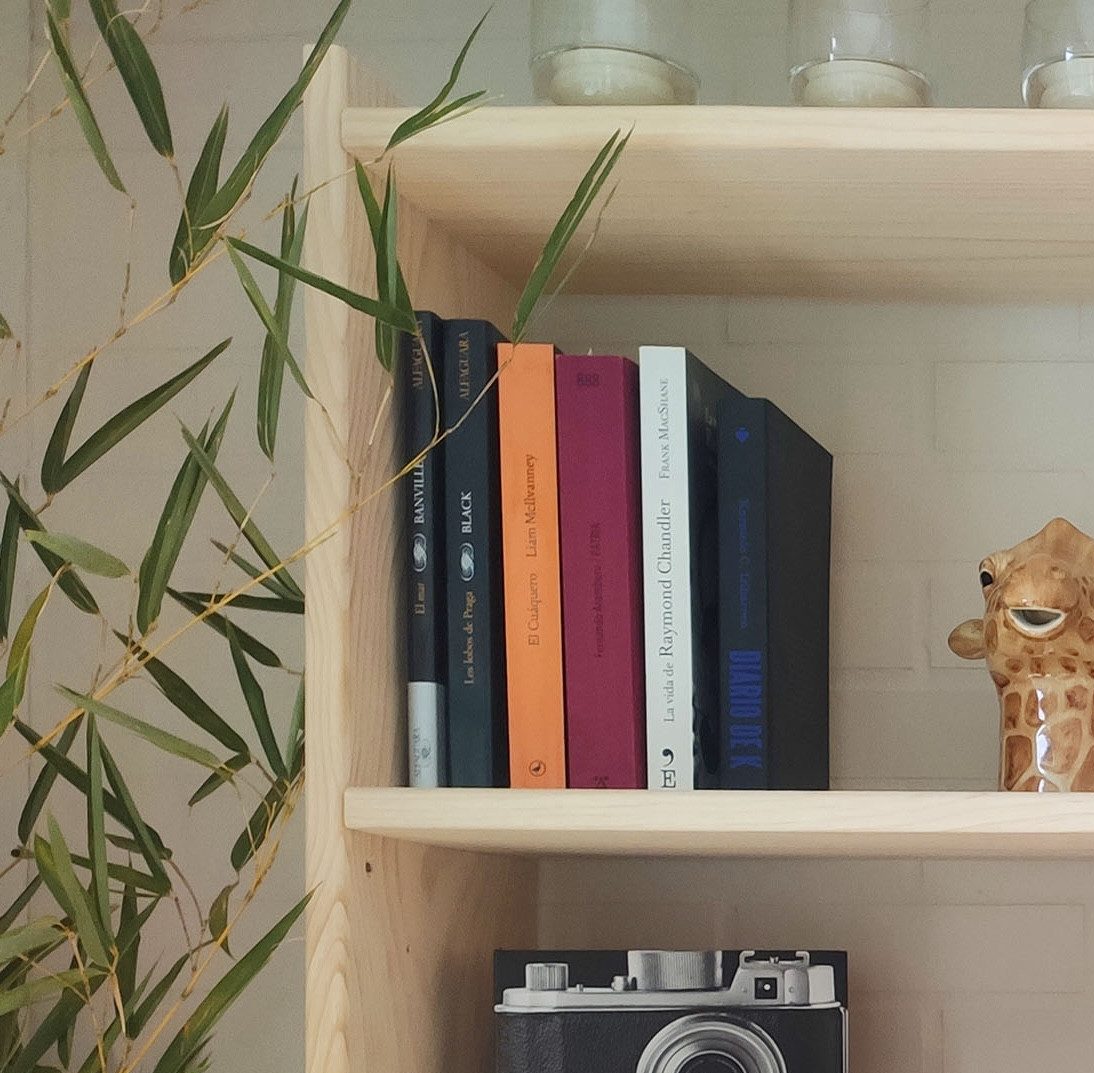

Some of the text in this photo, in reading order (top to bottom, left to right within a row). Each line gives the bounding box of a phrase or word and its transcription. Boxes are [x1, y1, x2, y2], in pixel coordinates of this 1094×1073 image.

[458, 331, 469, 400] ALFAGUARA
[461, 490, 472, 533] BLACK
[523, 454, 537, 558] Liam McIlvanney
[415, 603, 425, 614] El
[463, 591, 476, 684] Los lobos de Praga
[527, 572, 542, 646] El Cuáquero
[656, 499, 679, 723] La vida de Raymond Chandler
